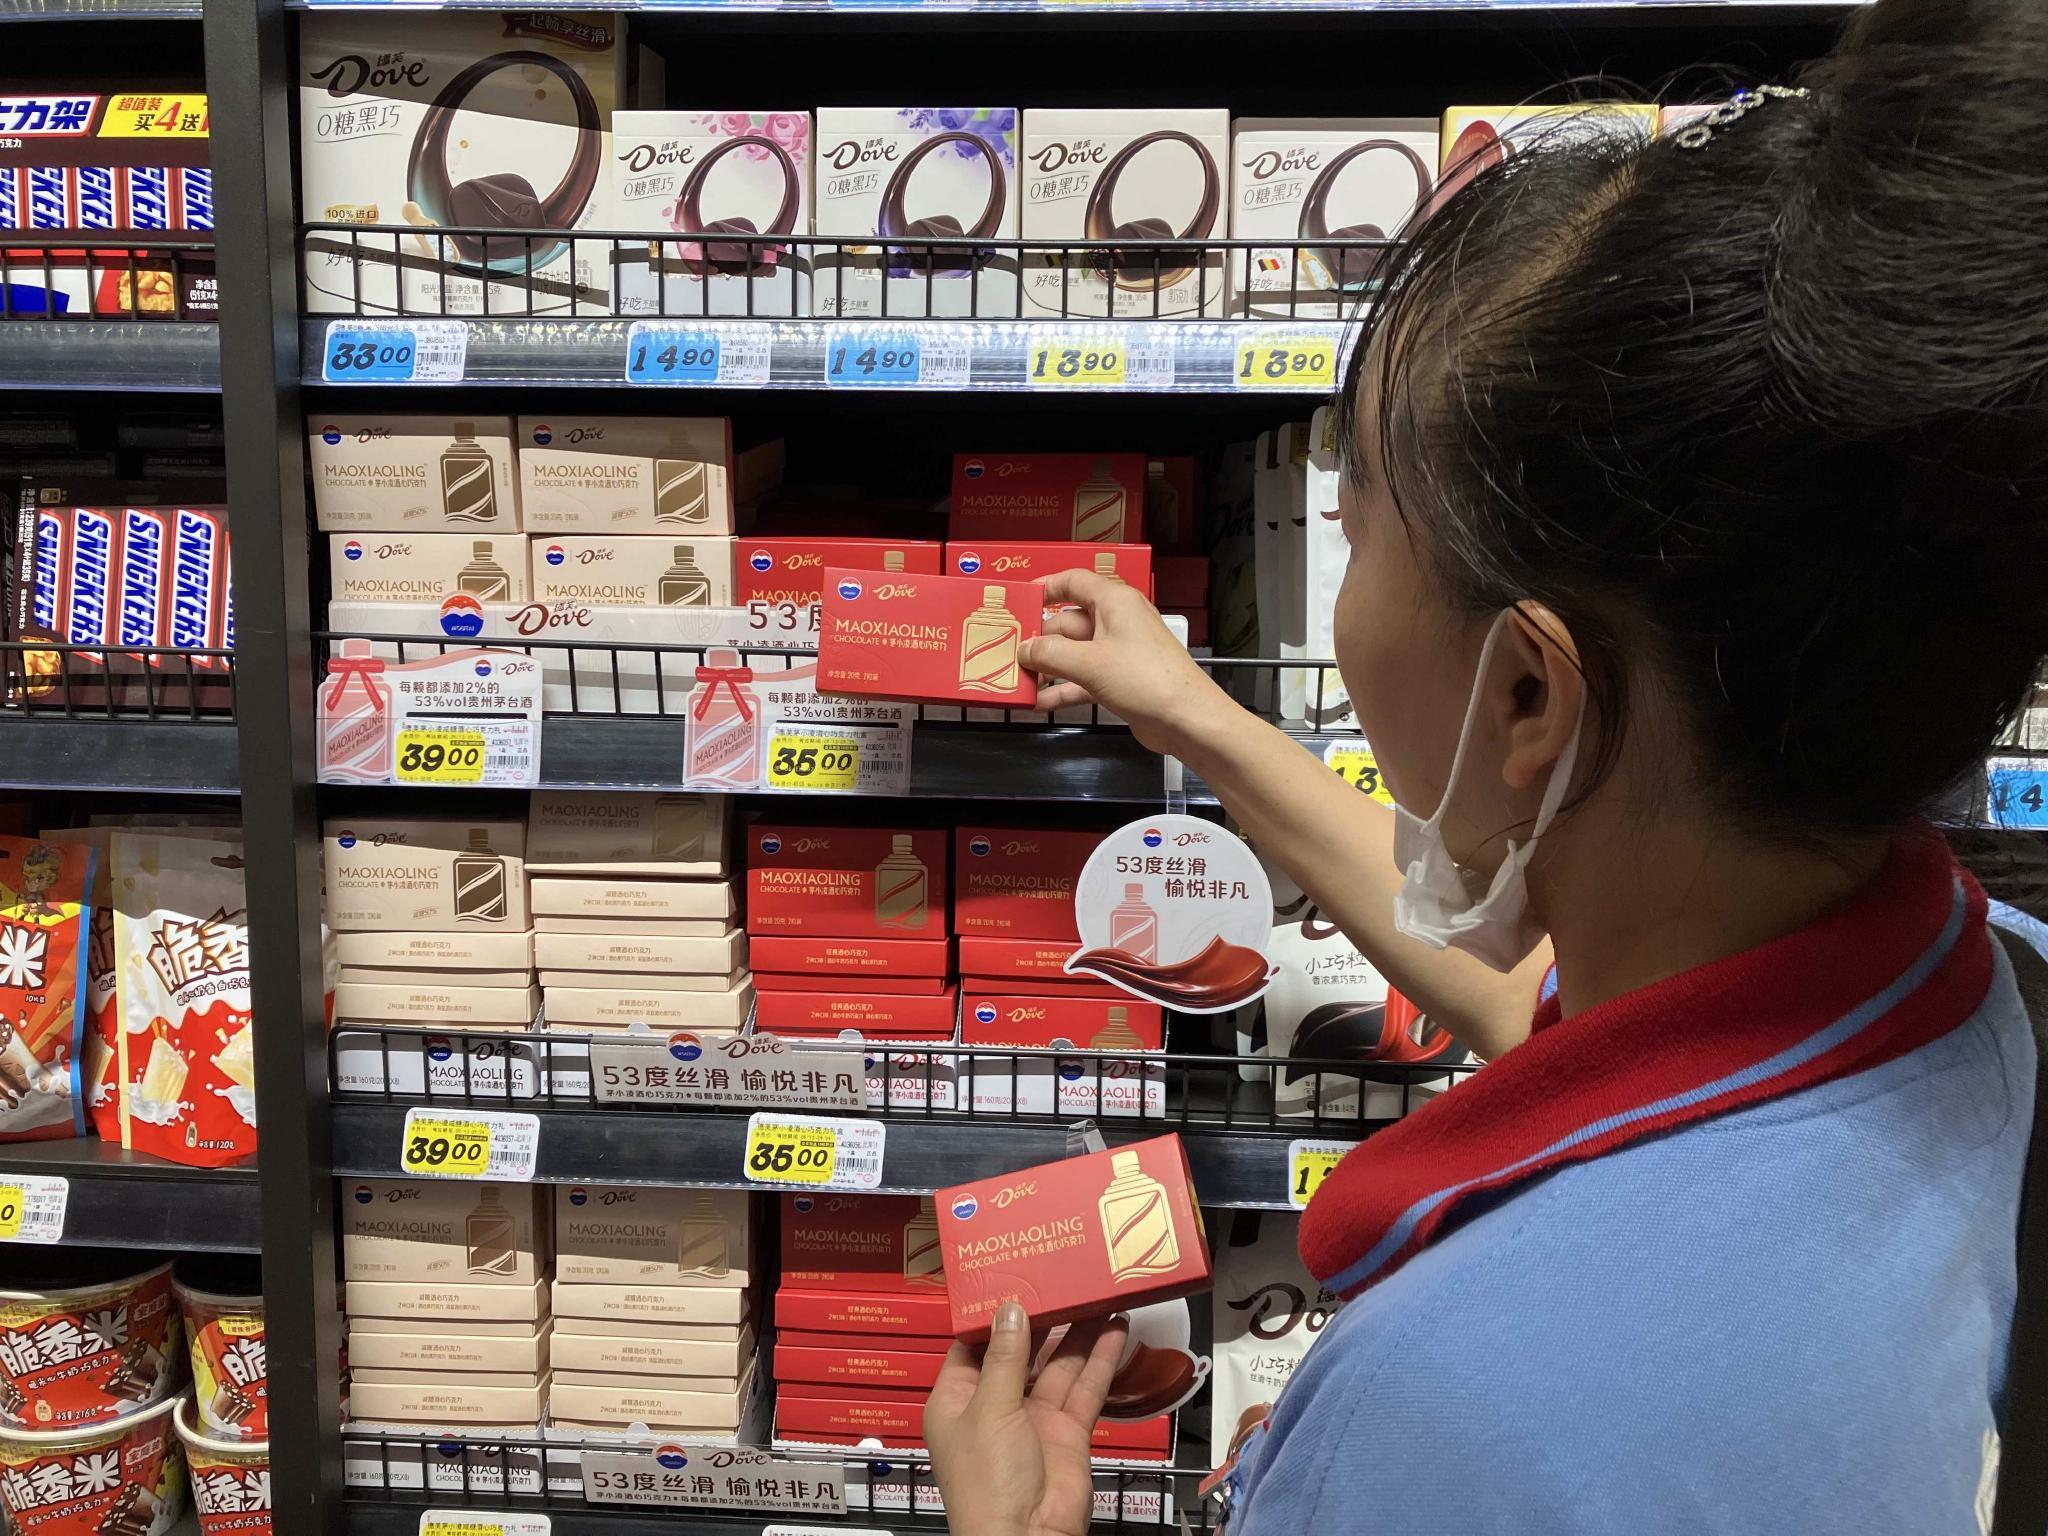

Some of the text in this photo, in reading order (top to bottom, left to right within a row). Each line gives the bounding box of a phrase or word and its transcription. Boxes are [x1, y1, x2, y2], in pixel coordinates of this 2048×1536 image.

[310, 54, 430, 98] Dove
[117, 97, 163, 111] 超值装
[618, 144, 695, 173] Dove
[823, 141, 900, 170] Dove
[1028, 142, 1108, 173] Dove
[1243, 150, 1322, 180] Dove
[352, 427, 392, 444] Dove
[565, 427, 606, 444] Dove
[325, 465, 426, 478] MAOXIAOLING
[534, 465, 638, 478] MAOXIAOLING
[374, 544, 414, 560] Dove
[575, 548, 616, 565] Dove
[782, 553, 823, 571] Dove
[990, 554, 1032, 573] Dove
[344, 579, 443, 593] MAOXIAOLING
[546, 584, 646, 599] MAOXIAOLING
[872, 585, 918, 601] Dove
[505, 603, 594, 636] Dove
[836, 618, 948, 641] MAOXIAOLING
[834, 635, 880, 646] CHOCOLATE
[501, 661, 535, 676] Dove
[399, 681, 500, 694] 每颗都添加2%的
[415, 695, 533, 708] 53%vol贵州茅台酒
[783, 705, 902, 720] 53%vol贵州茅台酒
[1172, 833, 1212, 846] Dove
[338, 866, 439, 879] MAOXIAOLING
[1116, 856, 1207, 876] 53度丝滑
[760, 871, 861, 886] MAOXIAOLING
[760, 886, 800, 894] CHOCOLATE
[1165, 878, 1250, 900] 愉悦非凡
[1005, 1007, 1046, 1023] Dove
[718, 1039, 785, 1059] Dove
[603, 1065, 859, 1094] 53度丝滑 愉悦非凡
[606, 1088, 685, 1099] 茅小凌酒心巧克力
[990, 1183, 1038, 1209] Dove
[355, 1221, 451, 1235] MAOXIAOLING
[569, 1223, 667, 1238] MAOXIAOLING
[794, 1229, 891, 1246] MAOXIAOLING
[958, 1216, 1084, 1260] MAOXIAOLING
[959, 1250, 1011, 1272] CHOCOLATE
[0, 1303, 128, 1379] 脆香米
[703, 1451, 767, 1468] Dove
[2, 1449, 123, 1512] 脆香米
[592, 1471, 840, 1501] 53度丝滑 愉悦非凡
